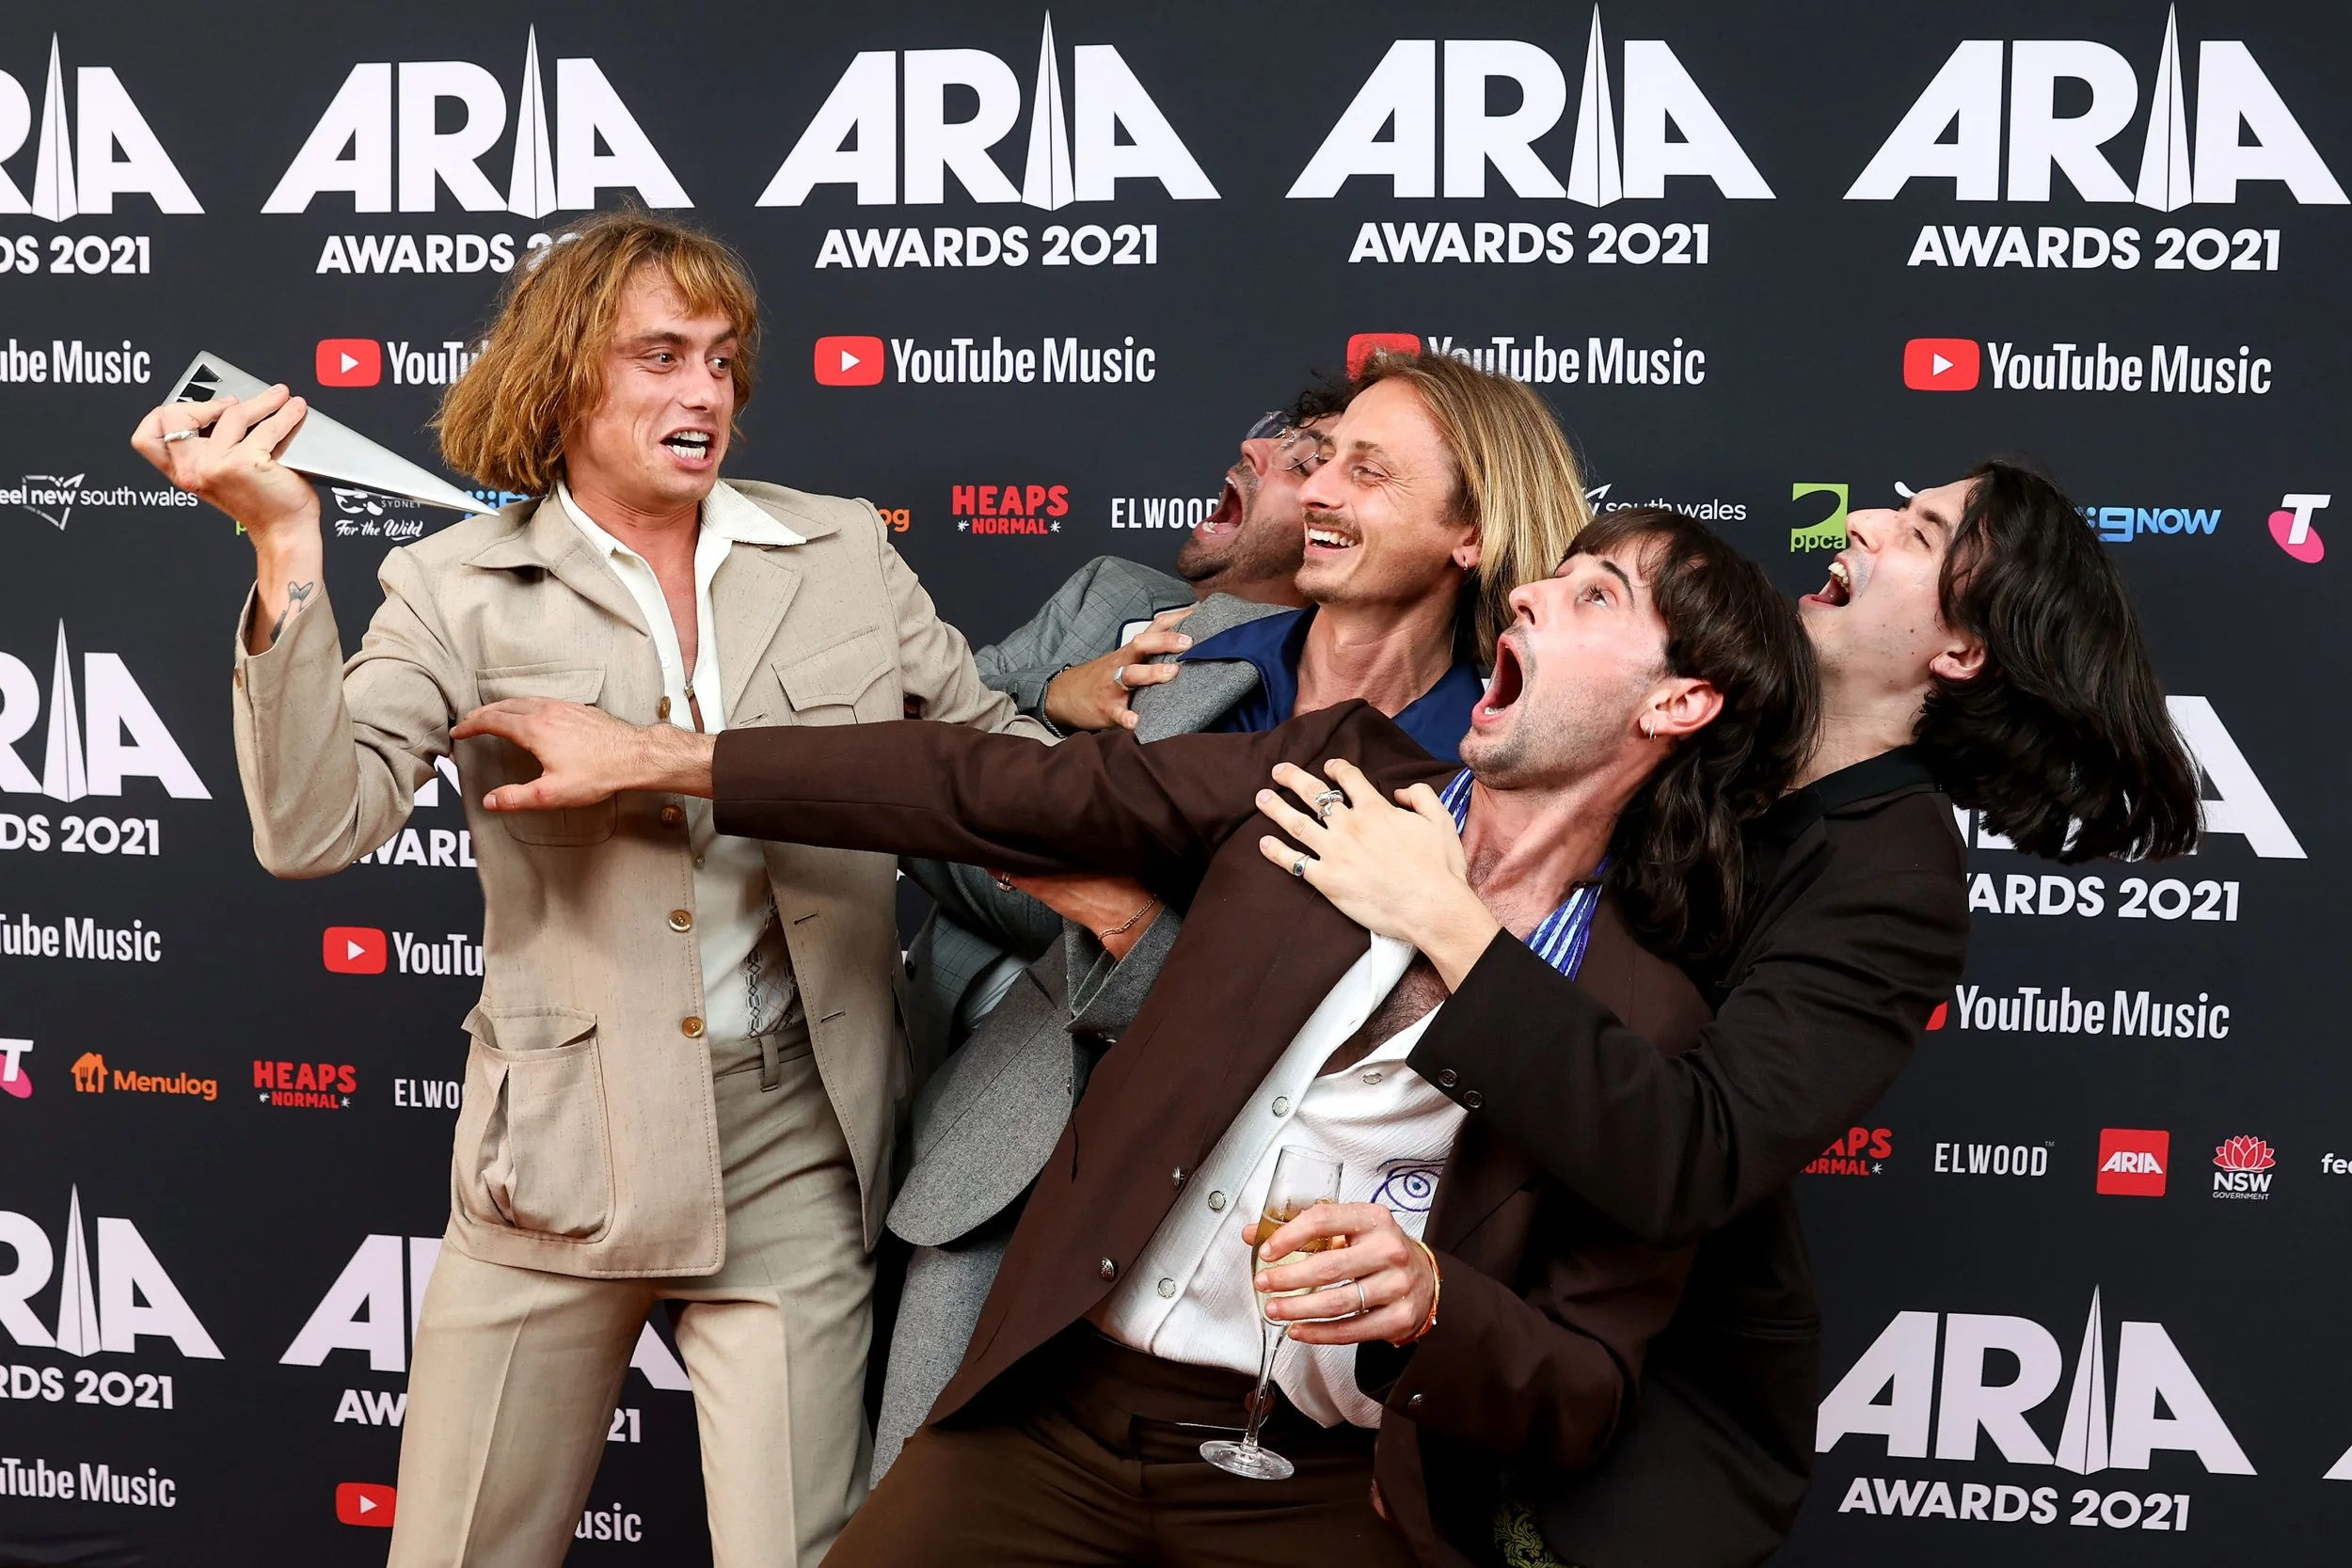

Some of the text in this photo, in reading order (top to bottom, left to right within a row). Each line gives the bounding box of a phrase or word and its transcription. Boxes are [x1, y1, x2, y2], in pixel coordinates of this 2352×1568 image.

[260, 22, 696, 220] ARIA
[754, 9, 1222, 212] ARIA
[1284, 3, 1777, 208] ARIA
[1842, 2, 2352, 213] ARIA
[0, 234, 151, 275] DS 2021
[315, 232, 516, 275] AWARDS
[814, 224, 1157, 269] AWARDS 2021
[1347, 222, 1709, 265] AWARDS 2021
[1906, 225, 2280, 271] AWARDS 2021
[52, 340, 151, 385] Music
[890, 336, 1156, 384] YouTube Music
[1587, 337, 1706, 385] Music
[1987, 341, 2272, 394] YouTube Music
[30, 487, 76, 507] new
[79, 482, 138, 508] south
[139, 485, 199, 508] wales
[952, 484, 1070, 517] HEAPS
[1677, 498, 1747, 521] wales
[333, 516, 425, 543] For the Wild
[972, 517, 1048, 535] NORMAL
[2280, 493, 2331, 545] T
[1790, 534, 1847, 553] ppca
[60, 816, 160, 856] 2021
[1966, 872, 2240, 922] ARDS 2021
[64, 916, 162, 962] Music
[391, 931, 484, 976] YouTu
[1955, 984, 2230, 1039] YouTube Music
[113, 1069, 217, 1101] Menulog
[253, 1060, 358, 1092] HEAPS
[393, 1077, 465, 1109] ELWO
[271, 1090, 340, 1109] NORMAL
[1820, 1126, 1894, 1160] APS
[1934, 1143, 2048, 1177] ELWOOD
[2100, 1151, 2164, 1175] ARIA
[1804, 1158, 1870, 1176] ORMAL
[2213, 1172, 2273, 1193] NSW
[2212, 1191, 2270, 1201] GOVERNMENT
[74, 1369, 173, 1410] 2021
[1815, 1286, 2258, 1476] ARIA
[79, 1463, 176, 1508] Music
[1837, 1477, 2190, 1531] AWARDS 2021
[574, 1502, 644, 1543] usic
